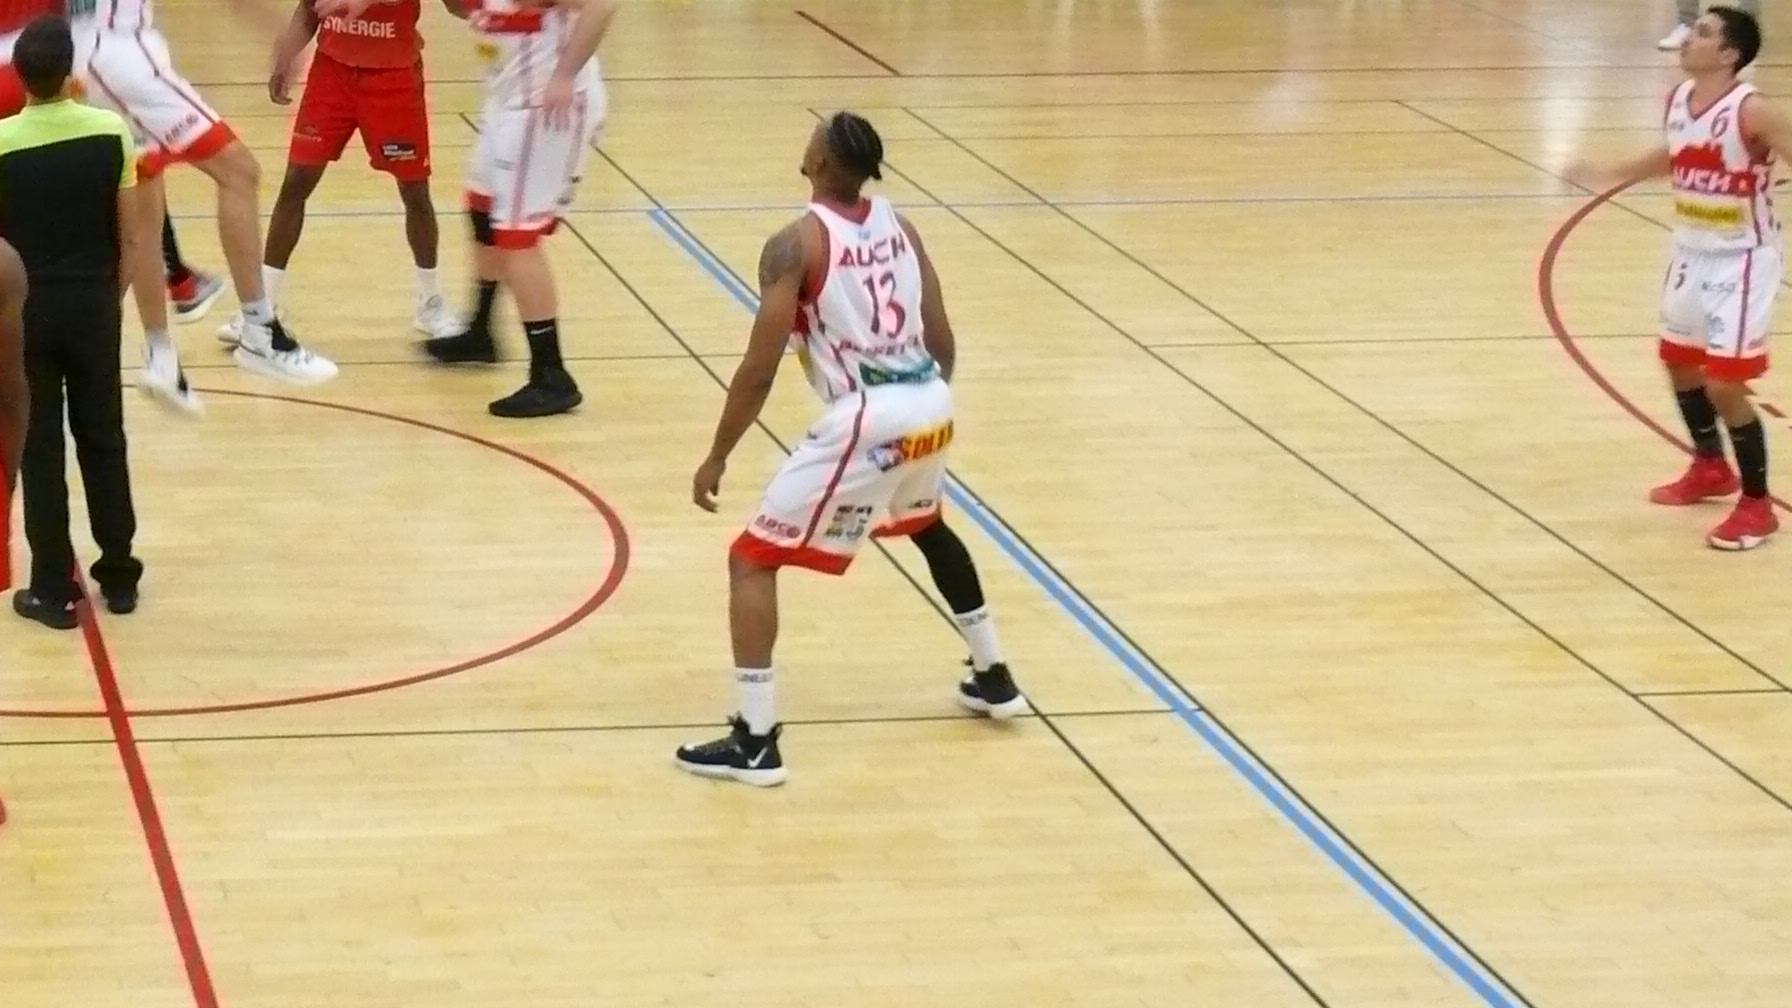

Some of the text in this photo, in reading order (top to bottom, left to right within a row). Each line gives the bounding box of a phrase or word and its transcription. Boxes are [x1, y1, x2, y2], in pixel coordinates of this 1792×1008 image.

[322, 15, 396, 39] SYNERGIE
[1710, 106, 1732, 138] 6
[838, 232, 906, 267] AUCH
[862, 270, 906, 339] 13
